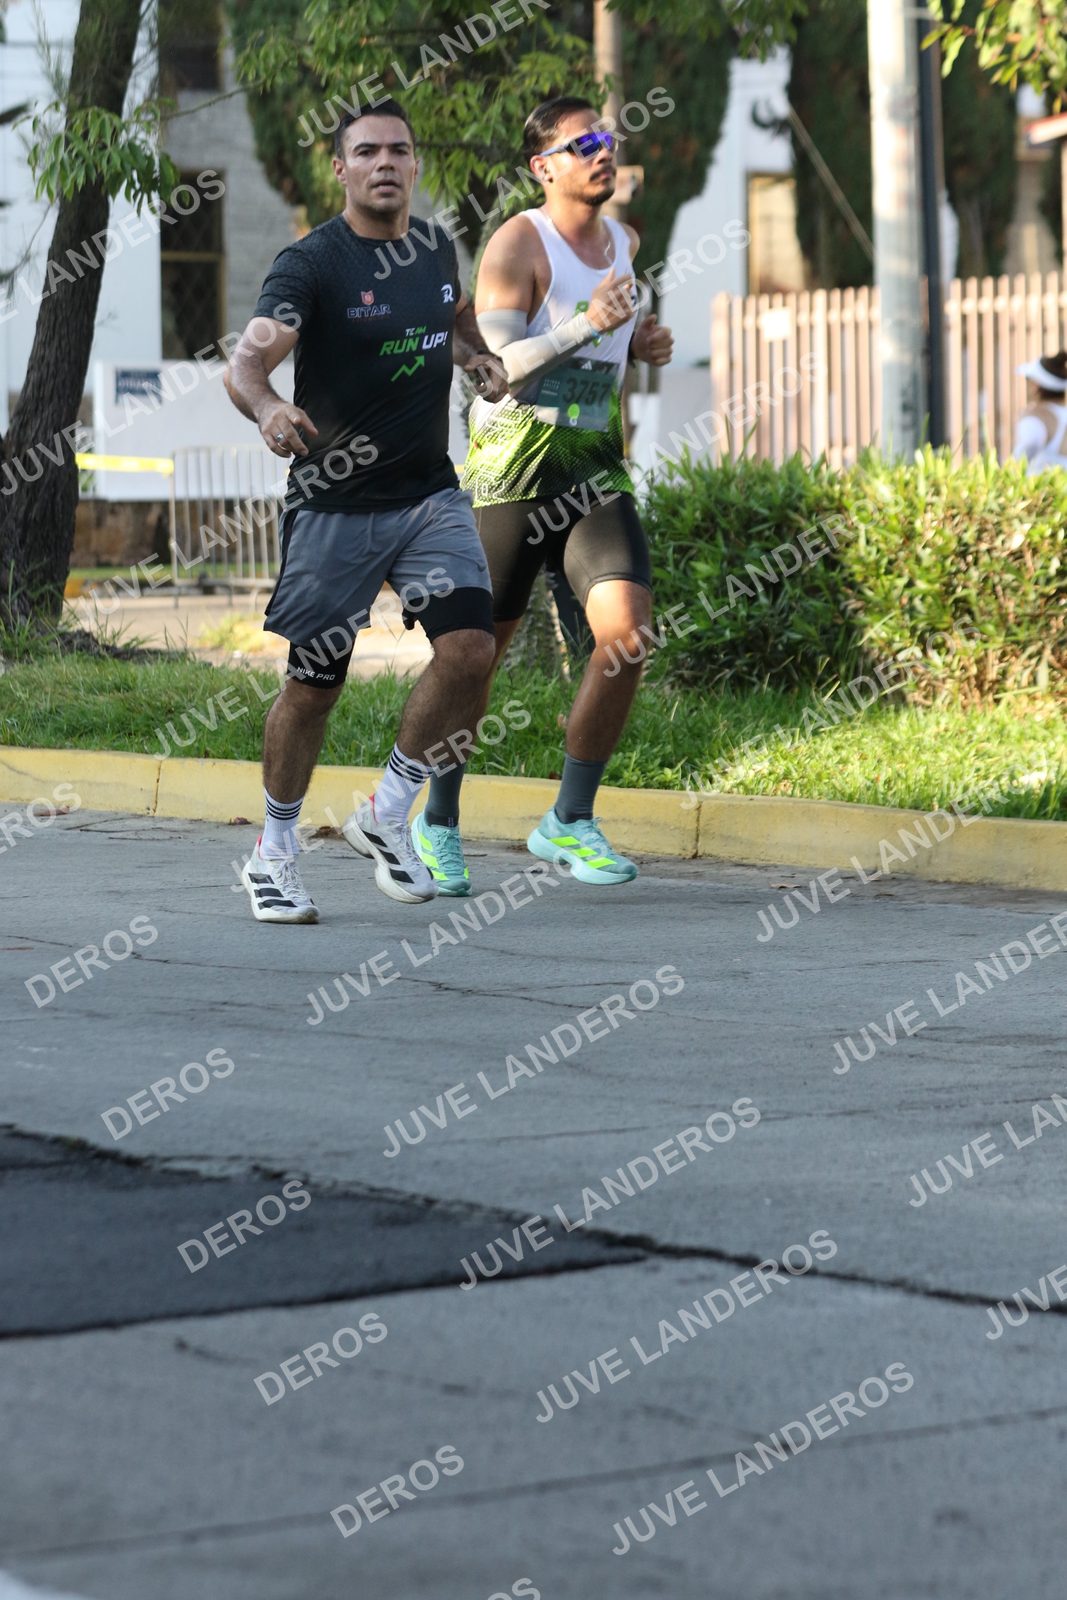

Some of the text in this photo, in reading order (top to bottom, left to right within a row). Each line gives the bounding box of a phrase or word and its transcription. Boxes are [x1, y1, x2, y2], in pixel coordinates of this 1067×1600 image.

[347, 303, 392, 319] BITAR
[379, 331, 448, 356] RUN UP!
[562, 376, 612, 407] 3757
[296, 666, 336, 681] NIKE PRO
